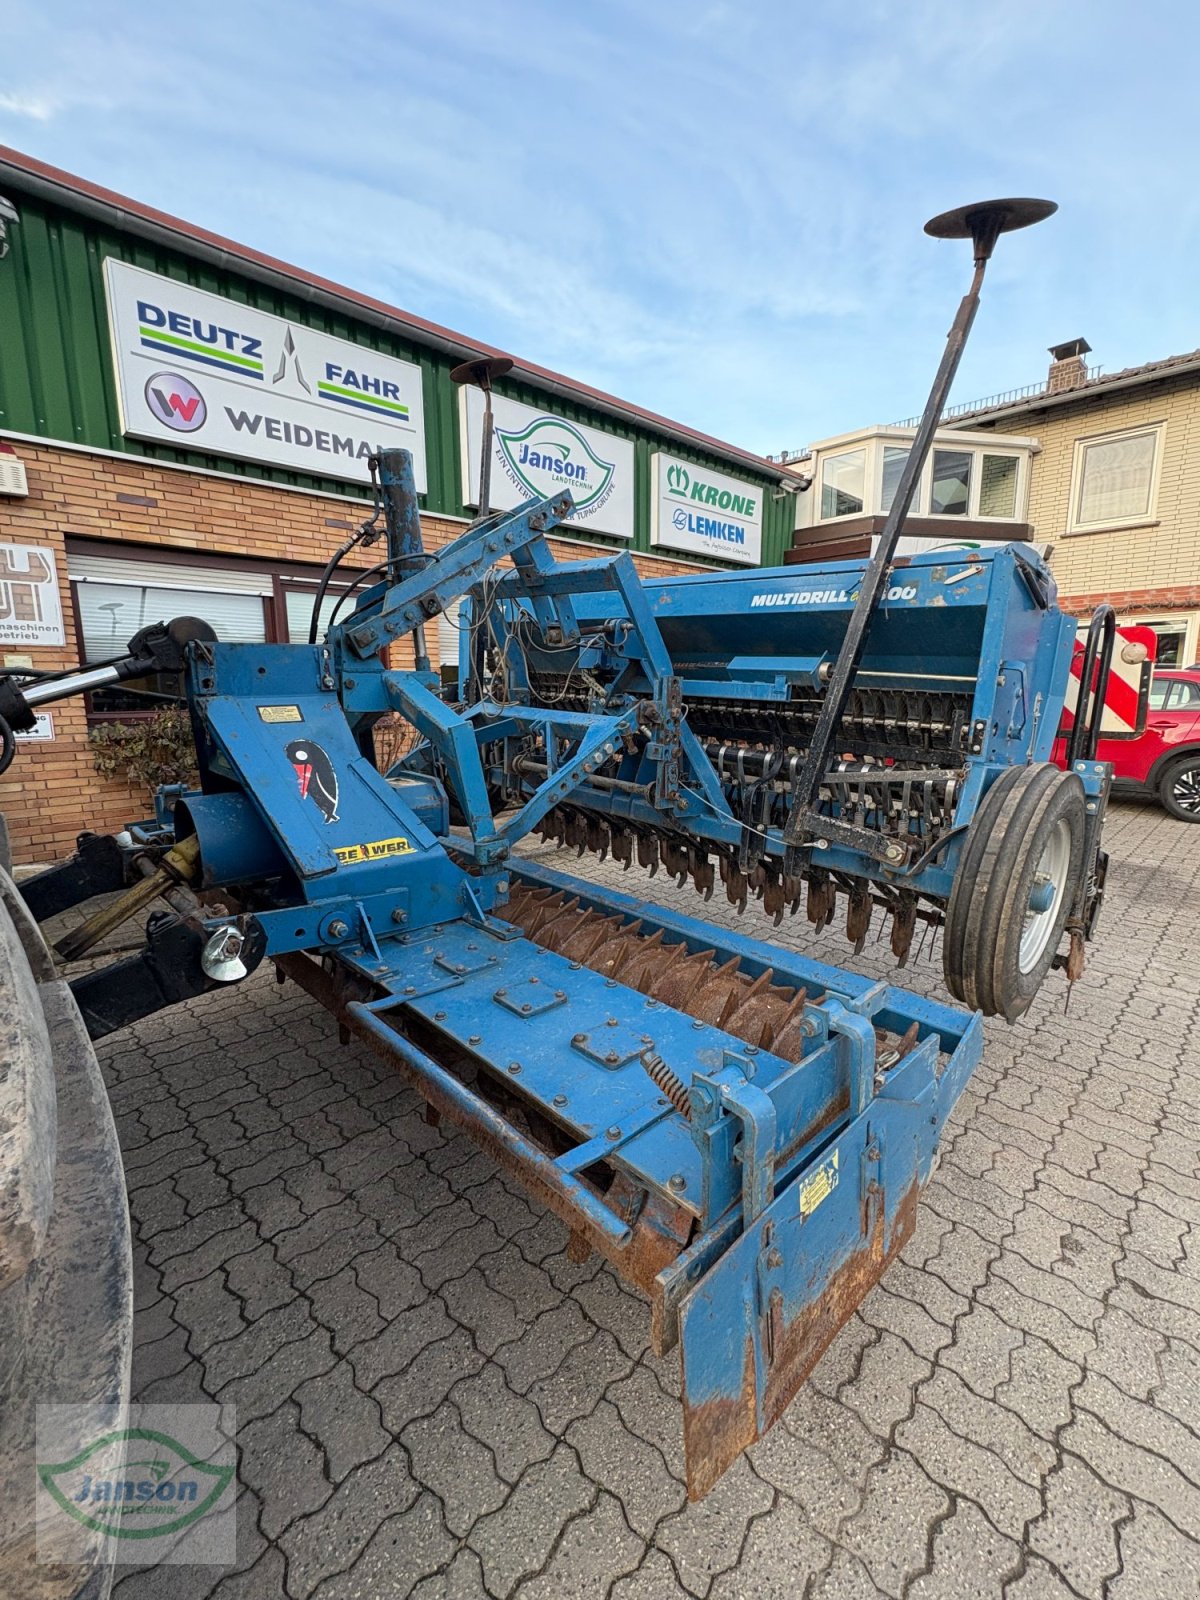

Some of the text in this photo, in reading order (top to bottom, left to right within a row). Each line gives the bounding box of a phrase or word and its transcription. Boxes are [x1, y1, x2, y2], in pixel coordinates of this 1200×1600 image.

[137, 300, 401, 401] DEUTZ FAHR
[223, 406, 387, 462] WEIDEMA
[519, 443, 586, 481] Janson
[495, 449, 508, 469] EIN
[505, 468, 532, 500] UNTER
[576, 482, 616, 520] TUPAG-GRUPPE
[551, 474, 593, 491] LANDTECHNIK
[690, 481, 756, 517] KRONE
[688, 513, 745, 545] LEMKEN
[751, 590, 848, 607] MULTIDRILL
